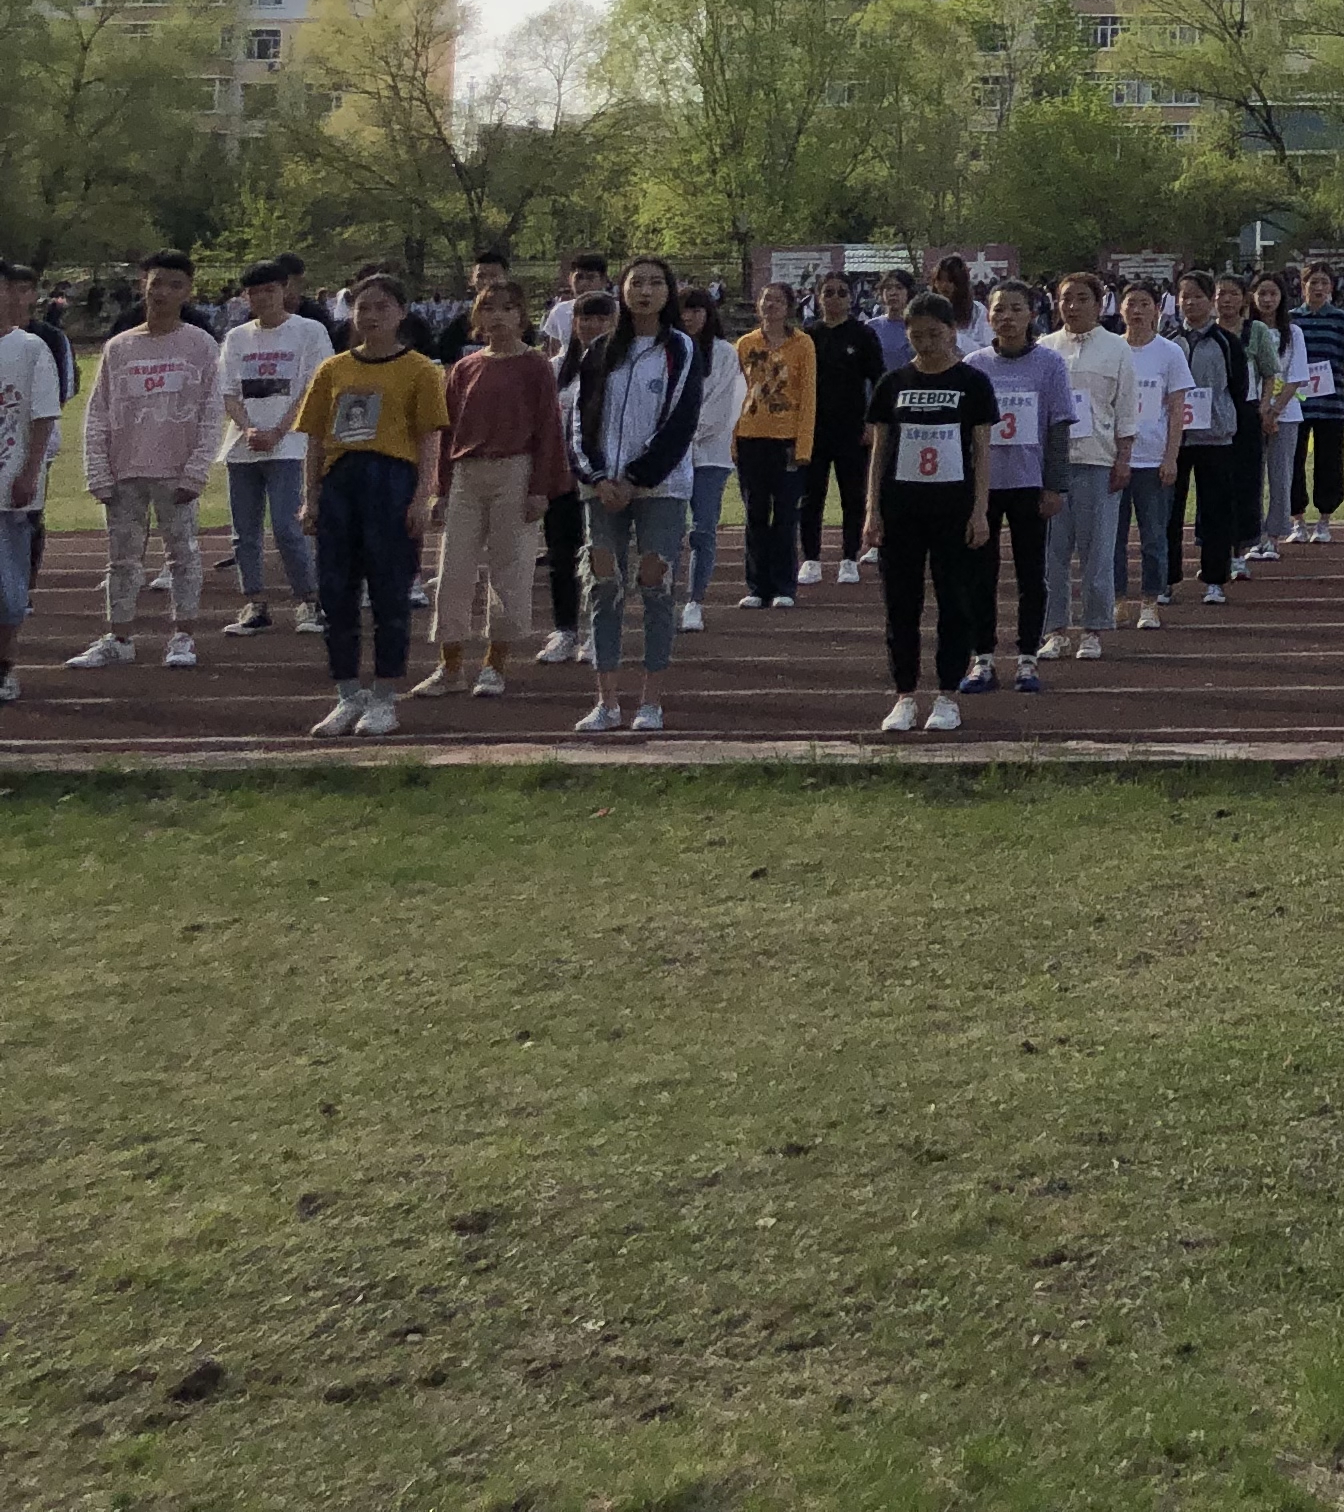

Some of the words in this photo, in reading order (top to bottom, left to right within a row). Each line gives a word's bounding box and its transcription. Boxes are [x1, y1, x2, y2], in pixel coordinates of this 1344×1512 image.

[901, 391, 958, 405] TEEBOX
[1000, 412, 1017, 439] 3
[919, 446, 938, 476] 8
